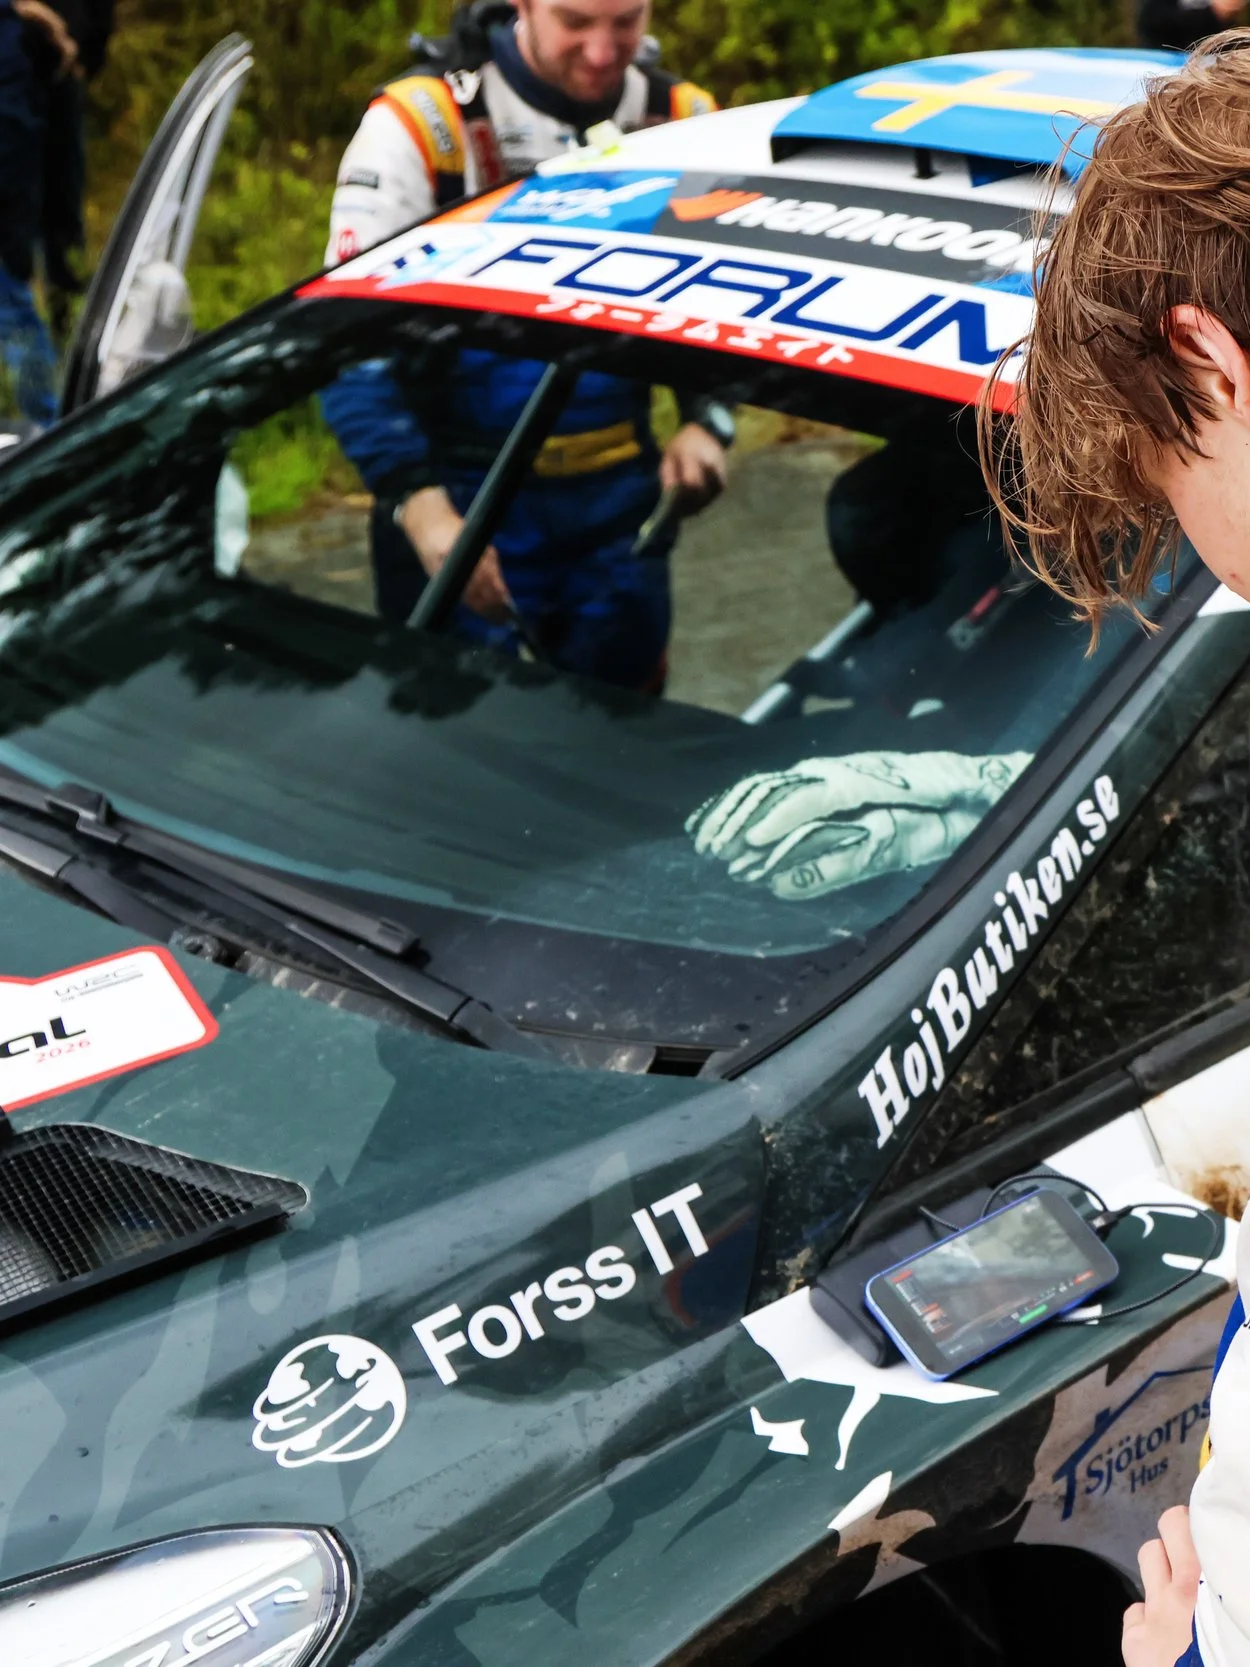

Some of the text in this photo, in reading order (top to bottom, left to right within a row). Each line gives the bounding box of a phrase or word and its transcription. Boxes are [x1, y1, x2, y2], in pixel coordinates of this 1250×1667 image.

[857, 774, 1120, 1150] HojButiken.se
[411, 1182, 710, 1387] Forss IT
[1084, 1396, 1210, 1496] Sjötorps
[1129, 1456, 1169, 1493] Hus
